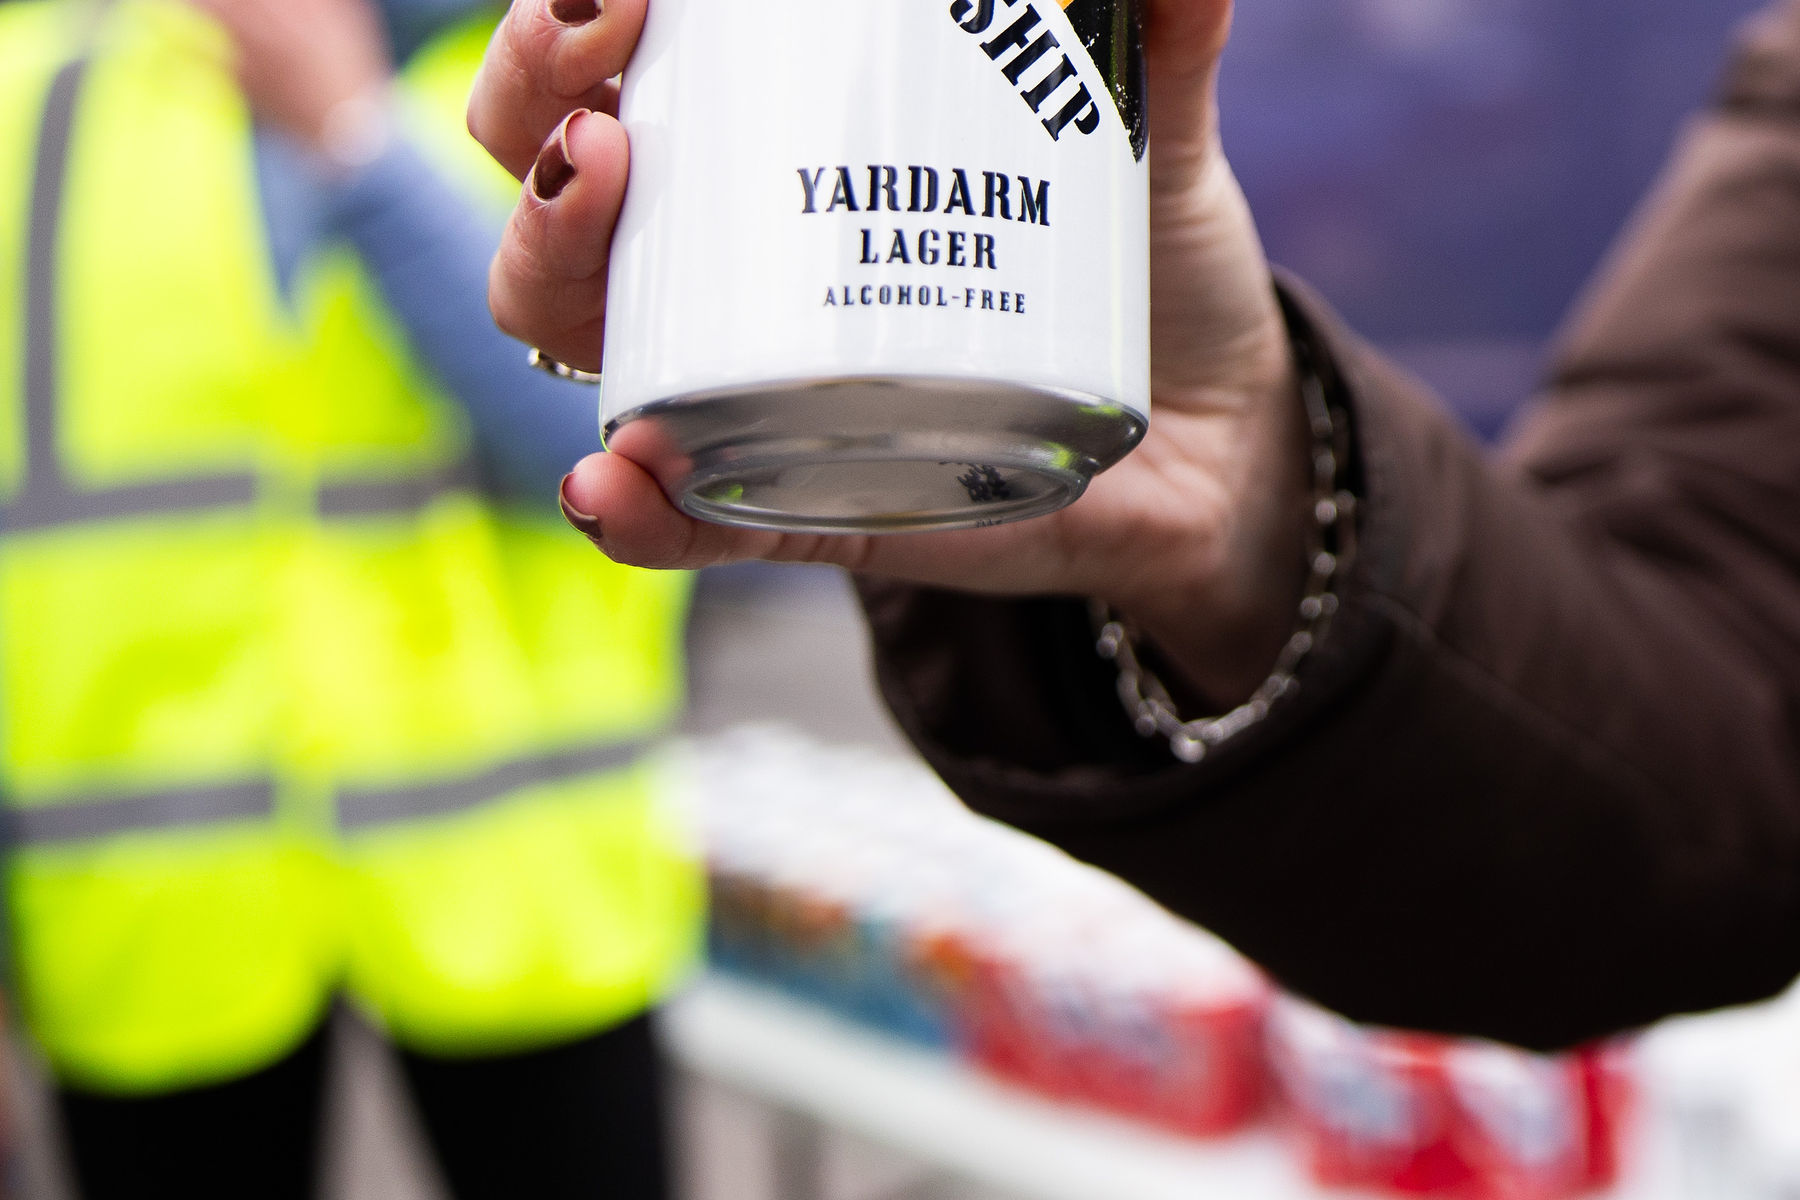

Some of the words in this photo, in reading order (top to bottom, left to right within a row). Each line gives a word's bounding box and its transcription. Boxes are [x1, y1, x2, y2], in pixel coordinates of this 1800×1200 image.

[796, 164, 1051, 227] YARDARM
[858, 228, 998, 271] LAGER
[822, 284, 1026, 314] ALCOHOL-FREE
